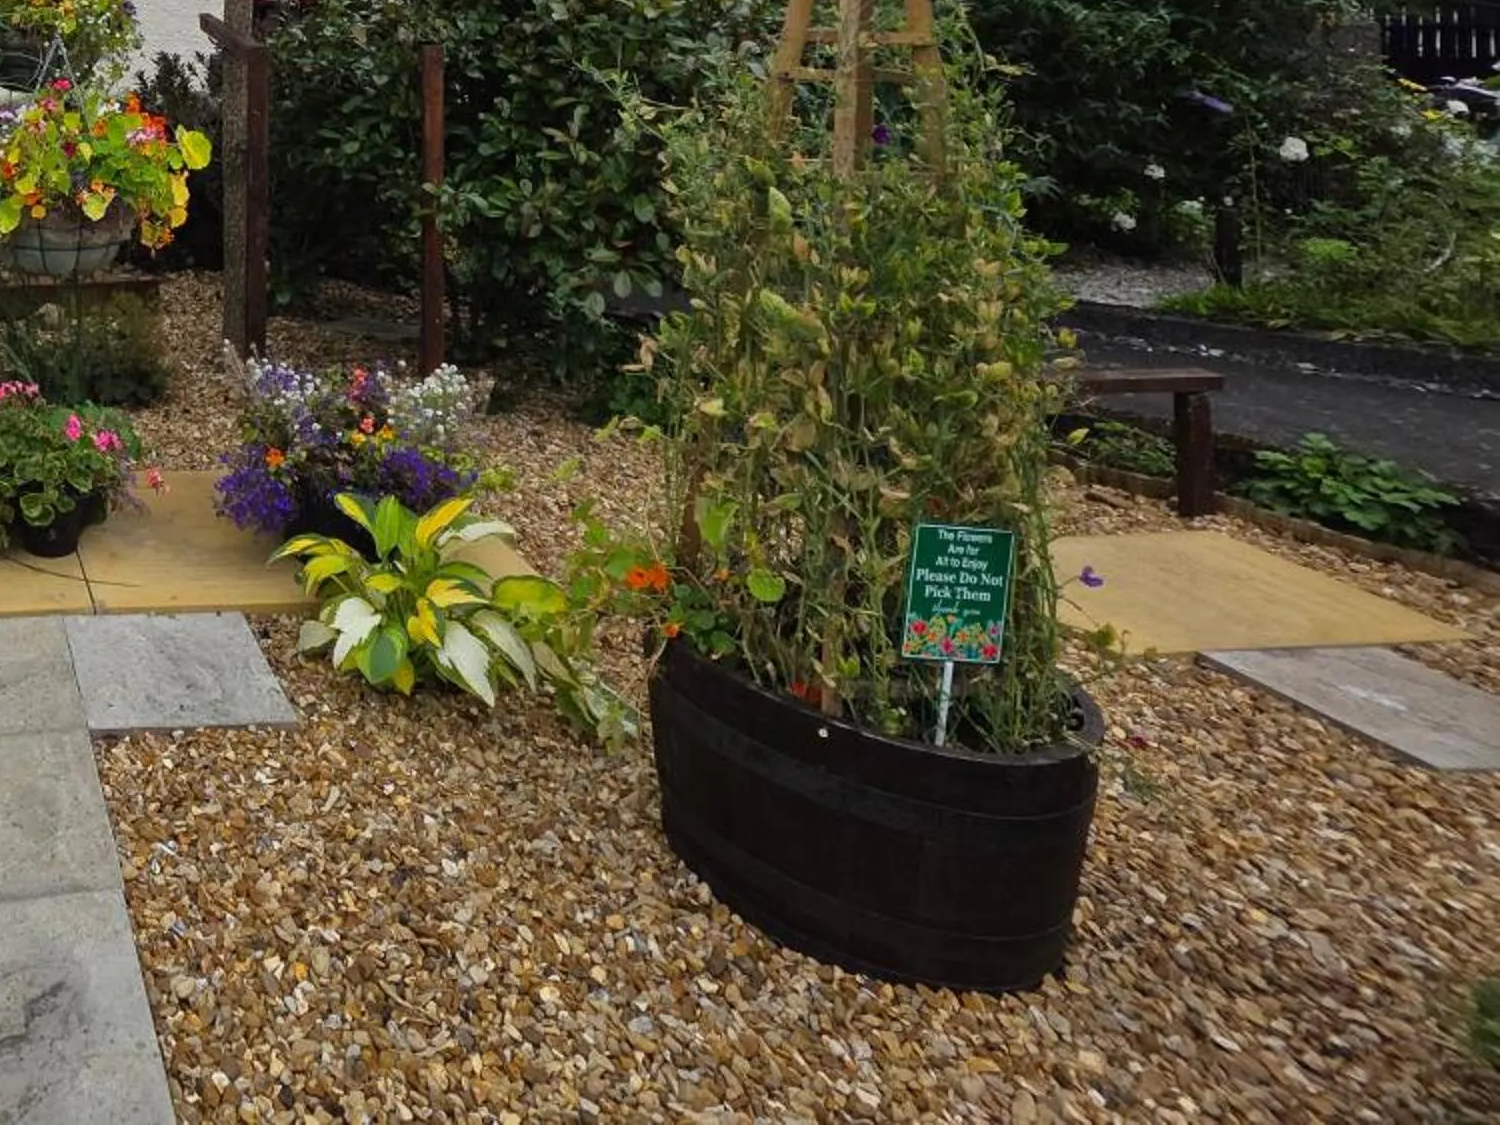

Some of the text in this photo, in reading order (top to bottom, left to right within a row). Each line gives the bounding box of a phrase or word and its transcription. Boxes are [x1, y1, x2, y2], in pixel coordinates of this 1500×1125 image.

[938, 528, 993, 544] The Flowers
[947, 543, 980, 556] Are for
[935, 555, 989, 572] All to Enjoy
[916, 568, 1003, 588] Please Do Not
[924, 584, 992, 602] Pick Them
